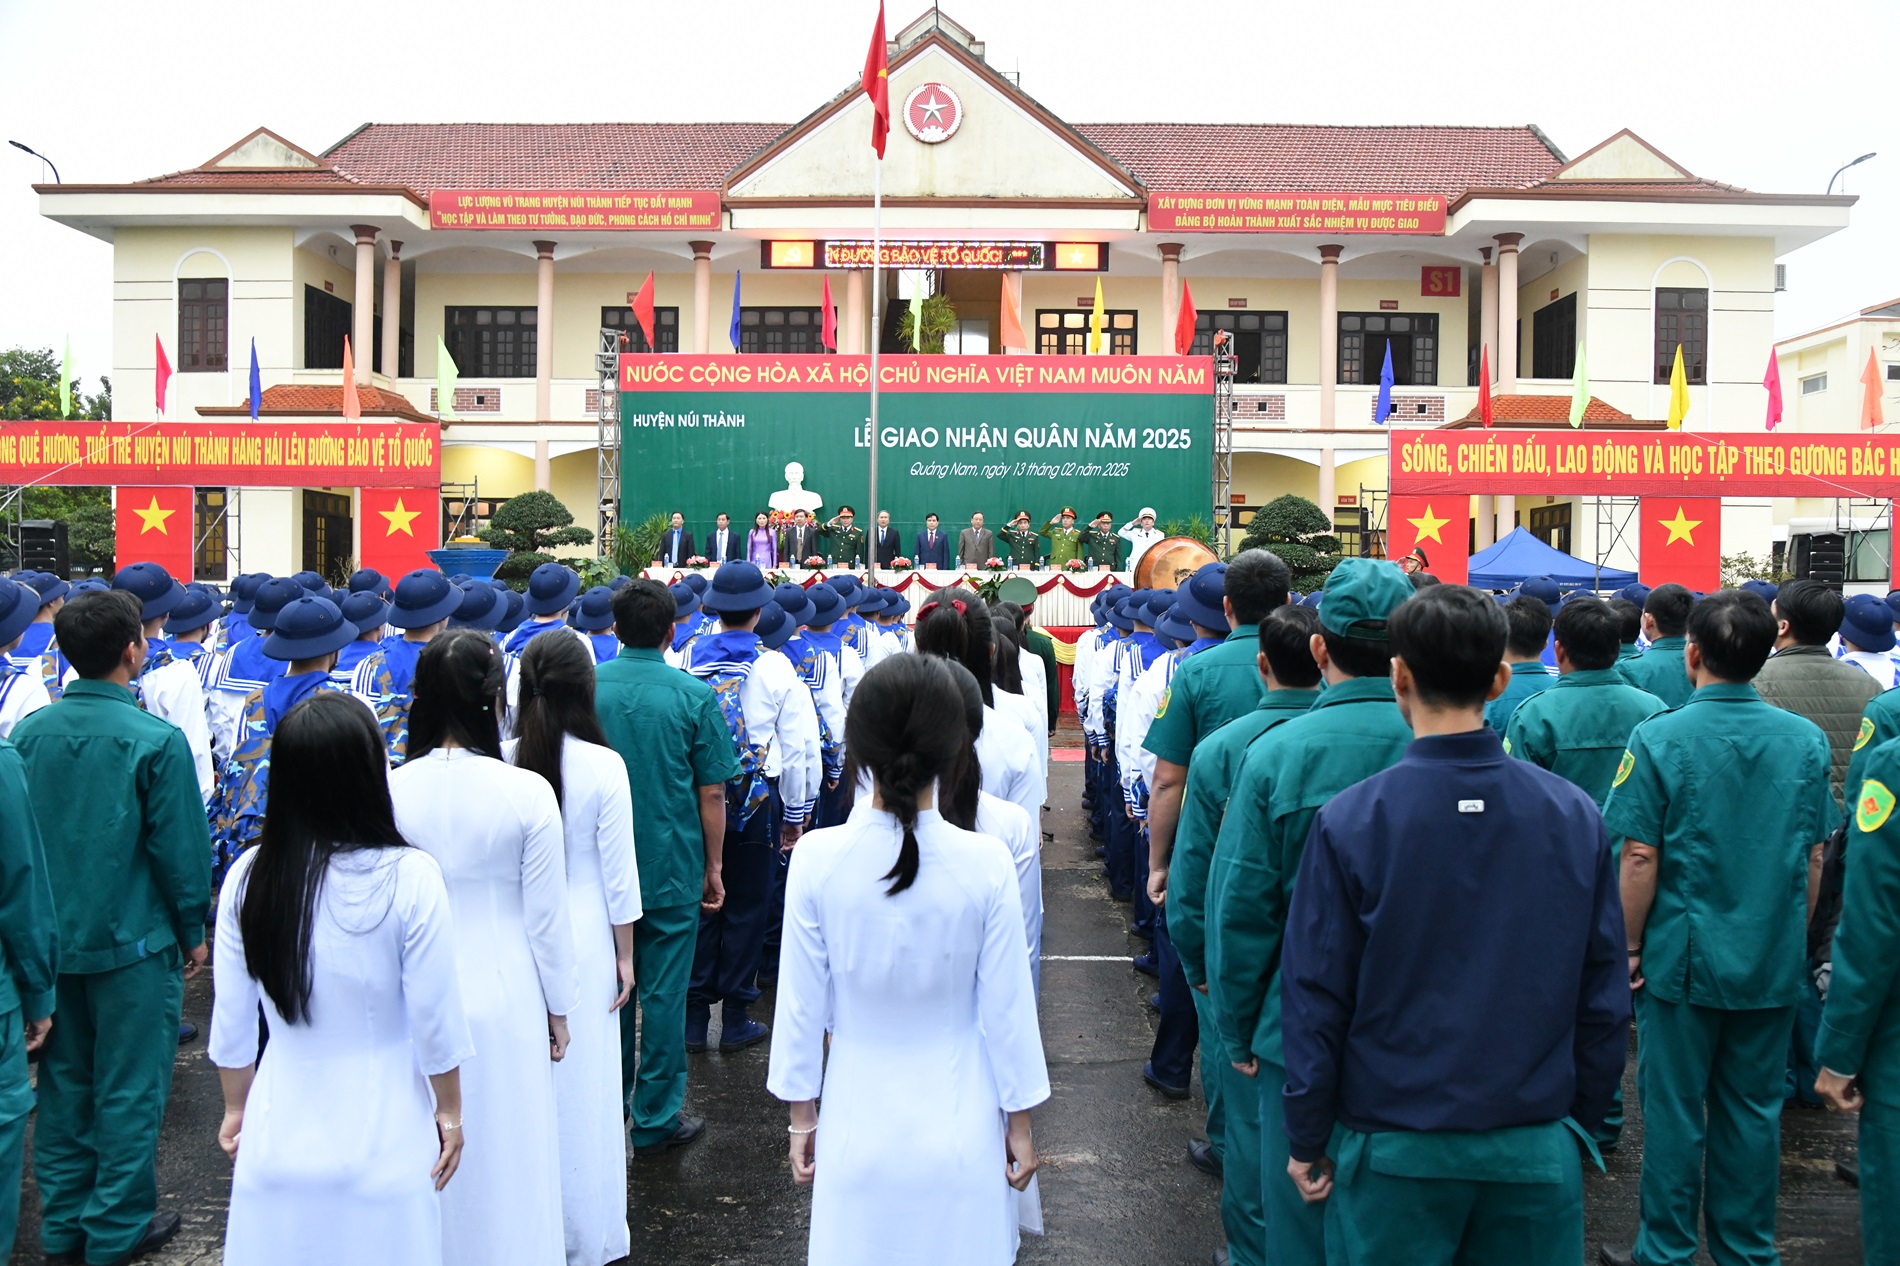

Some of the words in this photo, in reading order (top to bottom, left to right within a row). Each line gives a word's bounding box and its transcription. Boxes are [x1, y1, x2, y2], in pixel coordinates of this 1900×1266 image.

[458, 195, 473, 209] LỰC
[475, 196, 501, 209] LƯỢNG
[502, 195, 513, 207] VŨ
[515, 196, 540, 208] TRANG
[542, 195, 568, 210] HUYỆN
[570, 195, 584, 208] NÚI
[586, 195, 612, 208] THÀNH
[614, 194, 631, 208] TIẾP
[633, 197, 648, 210] TỤC
[668, 197, 692, 210] MẠNH
[1158, 196, 1176, 208] XÂY
[1178, 197, 1203, 211] DỰNG
[1206, 198, 1225, 209] ĐƠN
[1228, 199, 1236, 211] VỊ
[1239, 197, 1263, 209] VỮNG
[1266, 199, 1293, 212] MẠNH
[1296, 198, 1320, 210] TOÀN
[1322, 198, 1346, 212] DIỆN,
[1372, 199, 1393, 213] MỰC
[1396, 198, 1415, 211] TIÊU
[459, 212, 474, 226] TẬP
[476, 212, 486, 224] VÀ
[488, 212, 505, 224] LÀM
[507, 214, 526, 224] THEO
[528, 214, 539, 224] TƯ
[570, 215, 586, 227] ĐẠO
[588, 213, 607, 226] ĐỨC,
[609, 215, 636, 225] PHONG
[638, 213, 659, 225] CÁCH
[674, 213, 687, 225] CHÍ
[1175, 213, 1200, 226] ĐẢNG
[1203, 214, 1215, 228] BỘ
[1218, 214, 1243, 227] HOÀN
[1246, 214, 1275, 227] THÀNH
[1278, 213, 1301, 227] XUẤT
[1304, 214, 1322, 227] SẮC
[1324, 215, 1354, 230] NHIỆM
[1356, 218, 1368, 230] VỤ
[1371, 217, 1395, 230] ĐƯỢC
[1398, 218, 1419, 228] GIAO
[1430, 271, 1453, 292] S1
[627, 361, 684, 382] NƯỚC
[690, 362, 751, 386] CỘNG
[758, 361, 801, 383] HÒA
[806, 362, 834, 382] XÃ
[840, 362, 872, 387] HỘI
[880, 361, 920, 383] CHỦ
[927, 363, 990, 383] NGHĨA
[996, 363, 1034, 387] VIỆT
[1040, 367, 1085, 383] NAM
[1092, 364, 1151, 384] MUÔN
[1159, 364, 1204, 384] NĂM
[634, 412, 674, 429] HUYỆN
[679, 411, 699, 427] NÚI
[703, 411, 744, 427] THÀNH
[881, 427, 938, 447] GIAO
[946, 423, 1007, 452] NHẬN
[1015, 423, 1077, 448] QUÂN
[1086, 423, 1135, 448] NĂM
[1143, 428, 1191, 449] 2025
[0, 435, 16, 464] NG
[20, 430, 40, 467] QUÊ
[43, 433, 82, 468] HƯƠNG,
[85, 425, 109, 464] TUỔI
[112, 424, 131, 464] TRẺ
[134, 432, 169, 470] HUYỆN
[173, 431, 191, 464] NÚI
[194, 431, 229, 464] THÀNH
[232, 431, 261, 465] HĂNG
[265, 432, 282, 465] HÁI
[286, 432, 305, 465] LÊN
[308, 430, 344, 466] ĐƯỜNG
[348, 426, 369, 466] BẢO
[372, 432, 385, 472] VỆ
[388, 427, 402, 466] TỔ
[404, 428, 432, 469] QUỐC
[1402, 433, 1452, 476] SỐNG,
[1458, 434, 1507, 472] CHIẾN
[1512, 434, 1550, 476] ĐẤU,
[1556, 445, 1587, 473] LAO
[1592, 439, 1638, 480] ĐỘNG
[1643, 439, 1664, 473] VÀ
[1670, 445, 1702, 480] HỌC
[1707, 440, 1739, 481] TẬP
[1744, 446, 1785, 475] THEO
[1790, 444, 1846, 476] GƯƠNG
[1852, 441, 1885, 476] BÁC
[910, 461, 949, 479] Quảng
[949, 462, 978, 476] Nam,
[980, 462, 1011, 479] ngày
[1013, 462, 1026, 476] 13
[1026, 462, 1060, 479] tháng
[1060, 462, 1076, 476] 02
[1075, 463, 1102, 476] năm
[1102, 463, 1130, 476] 2025
